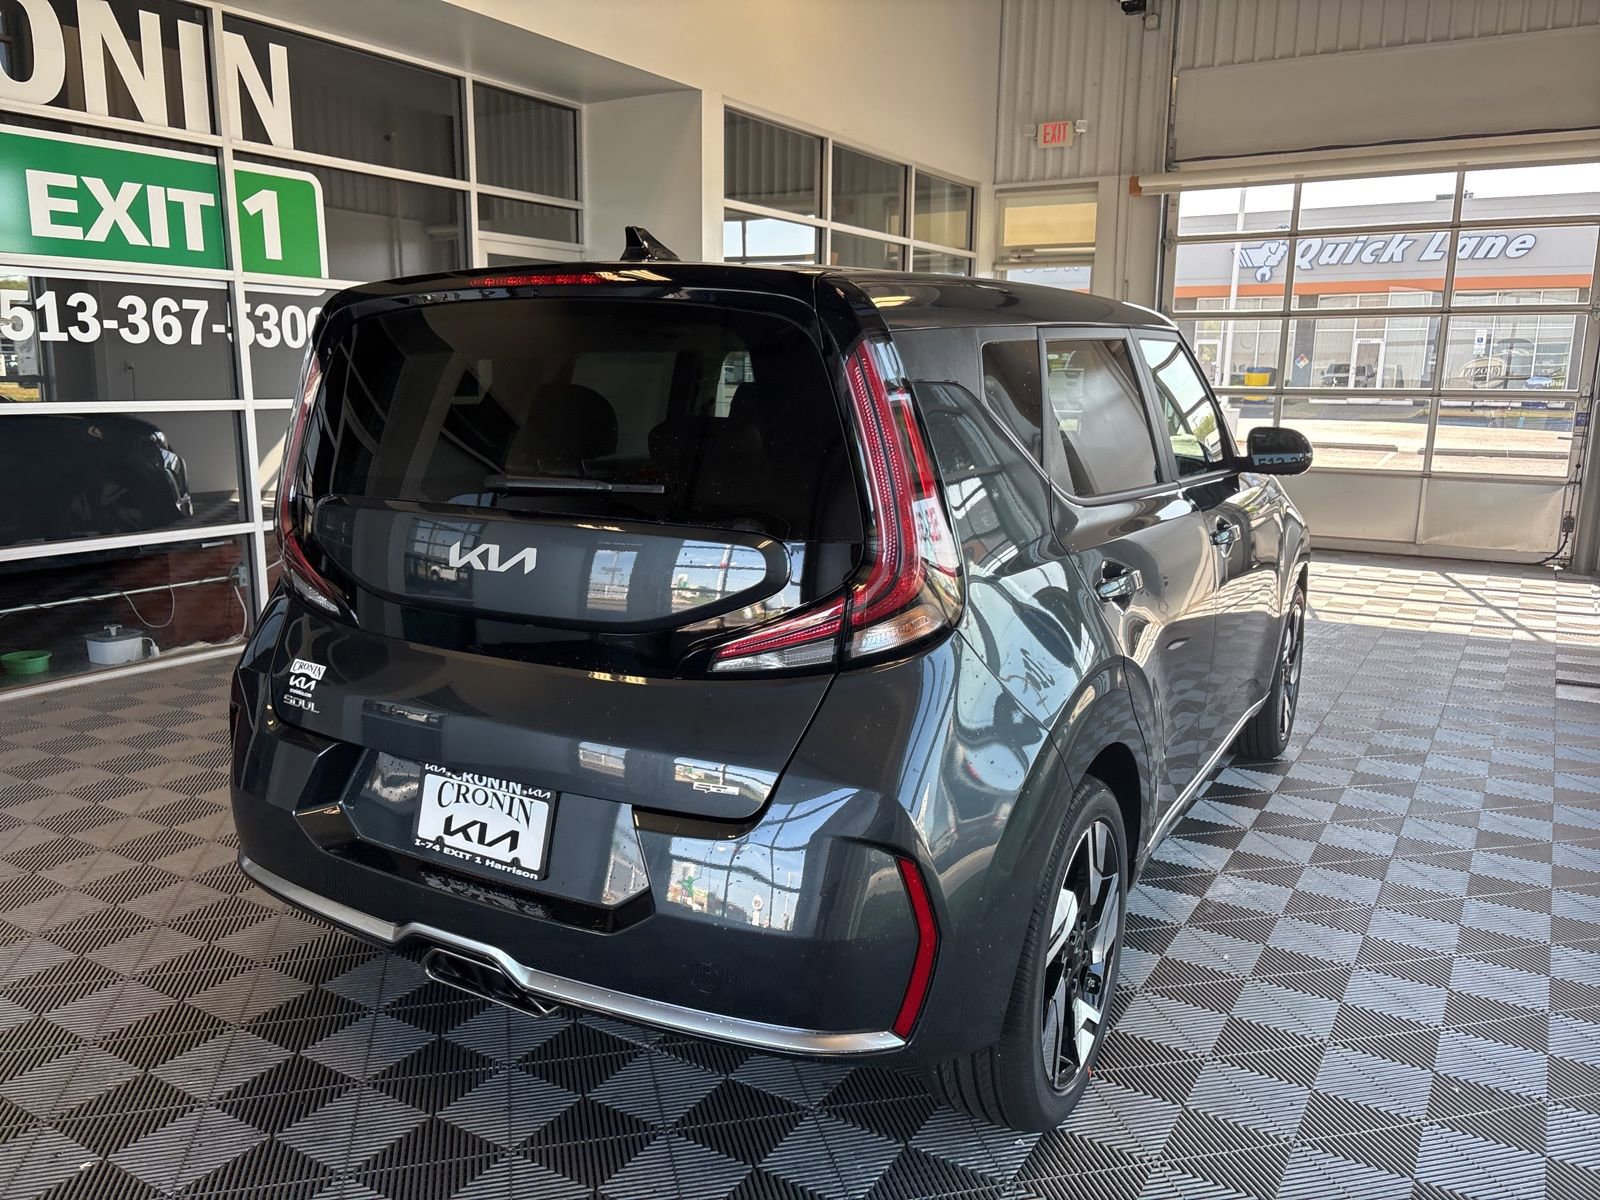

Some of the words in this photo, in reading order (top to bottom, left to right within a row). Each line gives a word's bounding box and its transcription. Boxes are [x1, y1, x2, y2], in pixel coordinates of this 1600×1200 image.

[1043, 123, 1069, 144] EXIT
[25, 169, 216, 252] EXIT
[242, 190, 283, 260] 1
[1295, 233, 1417, 270] Quick
[1418, 231, 1537, 261] Lane
[448, 541, 537, 575] KIA
[289, 674, 317, 691] KIA
[293, 660, 324, 678] CRONIN
[283, 693, 320, 714] SOUL
[437, 780, 533, 830] CRONIN
[443, 814, 520, 853] KIA
[414, 838, 441, 853] I-74
[443, 846, 473, 861] EXIT
[474, 856, 483, 865] 1
[485, 859, 538, 881] Harrison
